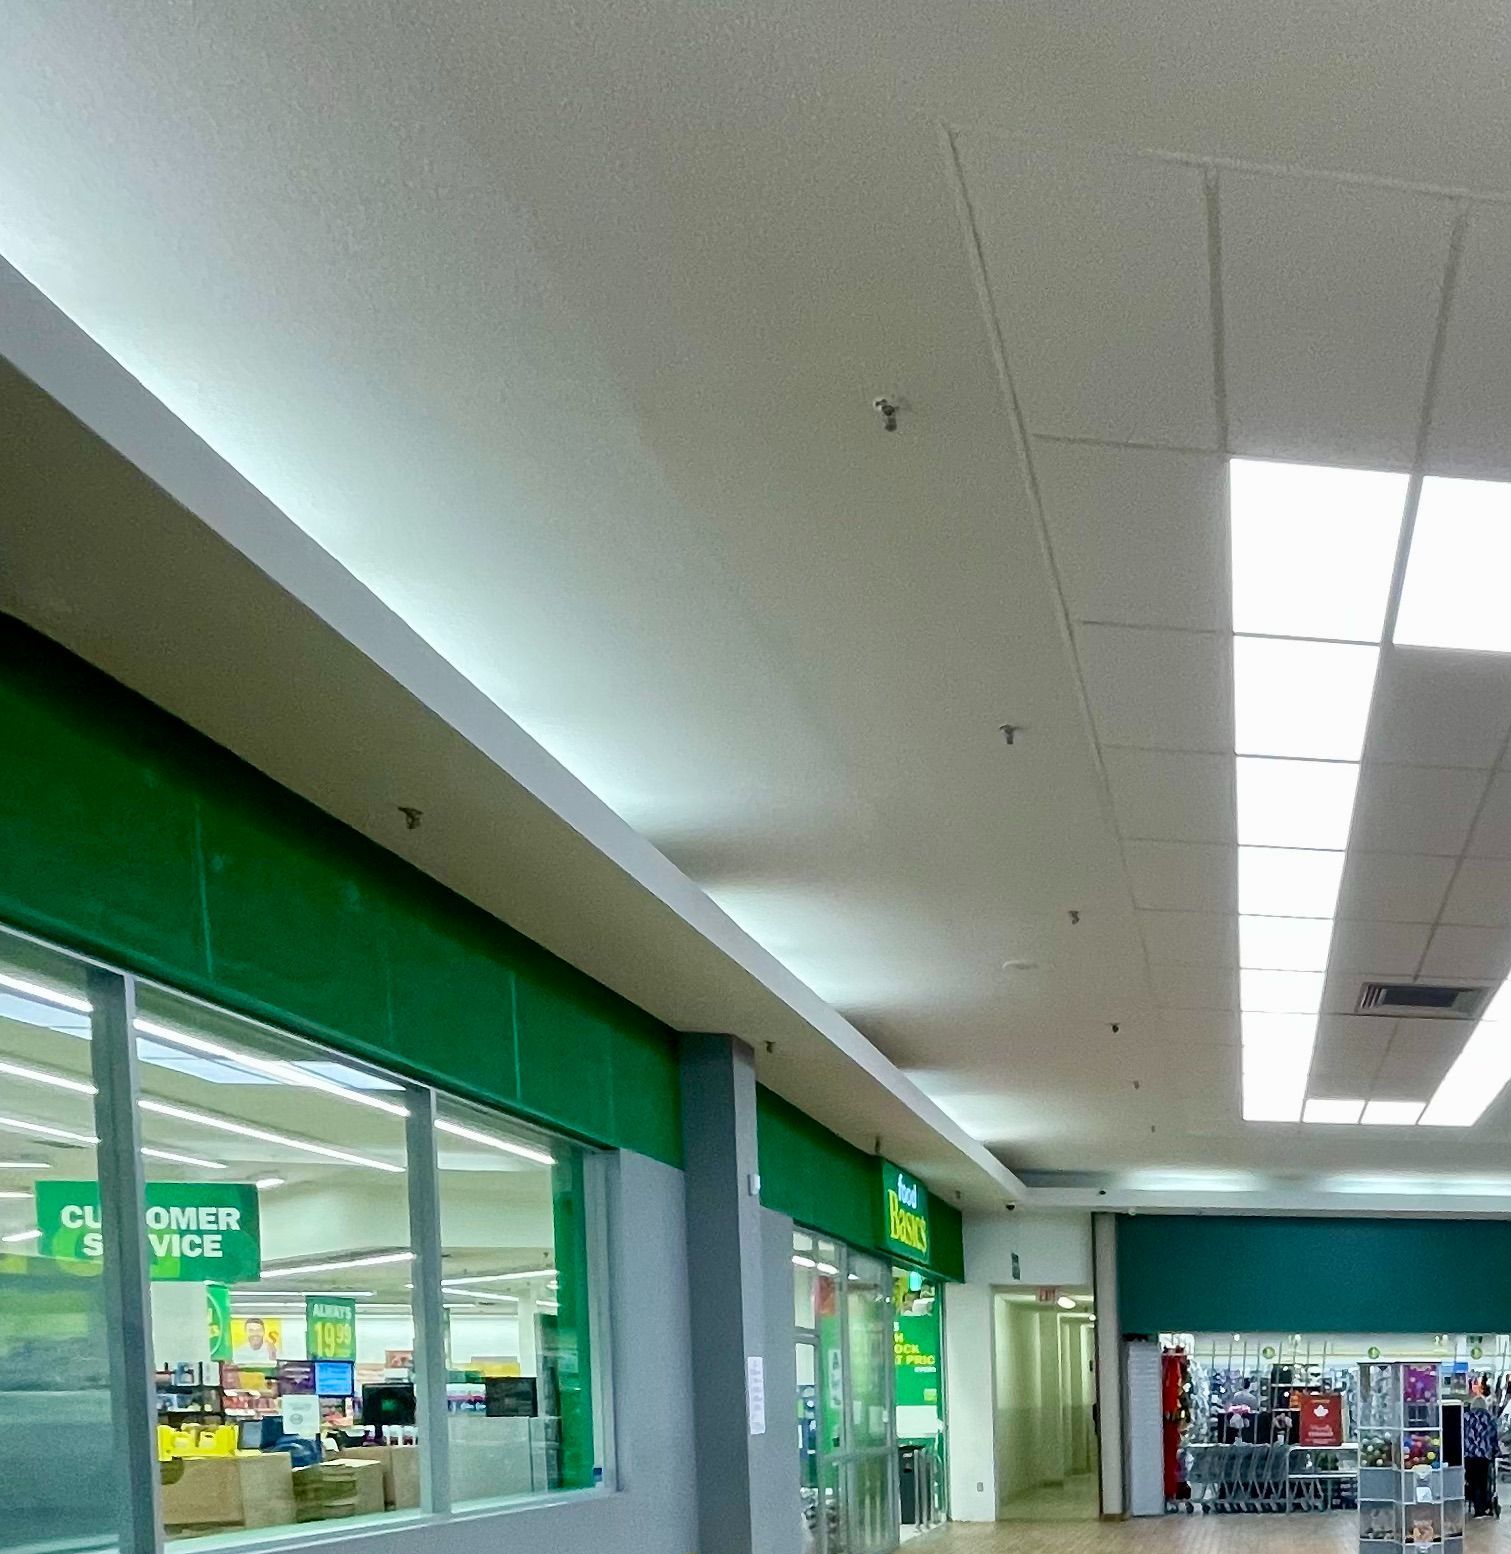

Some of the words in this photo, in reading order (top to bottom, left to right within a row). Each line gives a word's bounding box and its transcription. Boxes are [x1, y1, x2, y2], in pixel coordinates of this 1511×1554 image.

[897, 1173, 918, 1210] food
[60, 1205, 241, 1231] CUOMER
[83, 1233, 223, 1258] SVICE
[312, 1303, 352, 1320] ALWAYS
